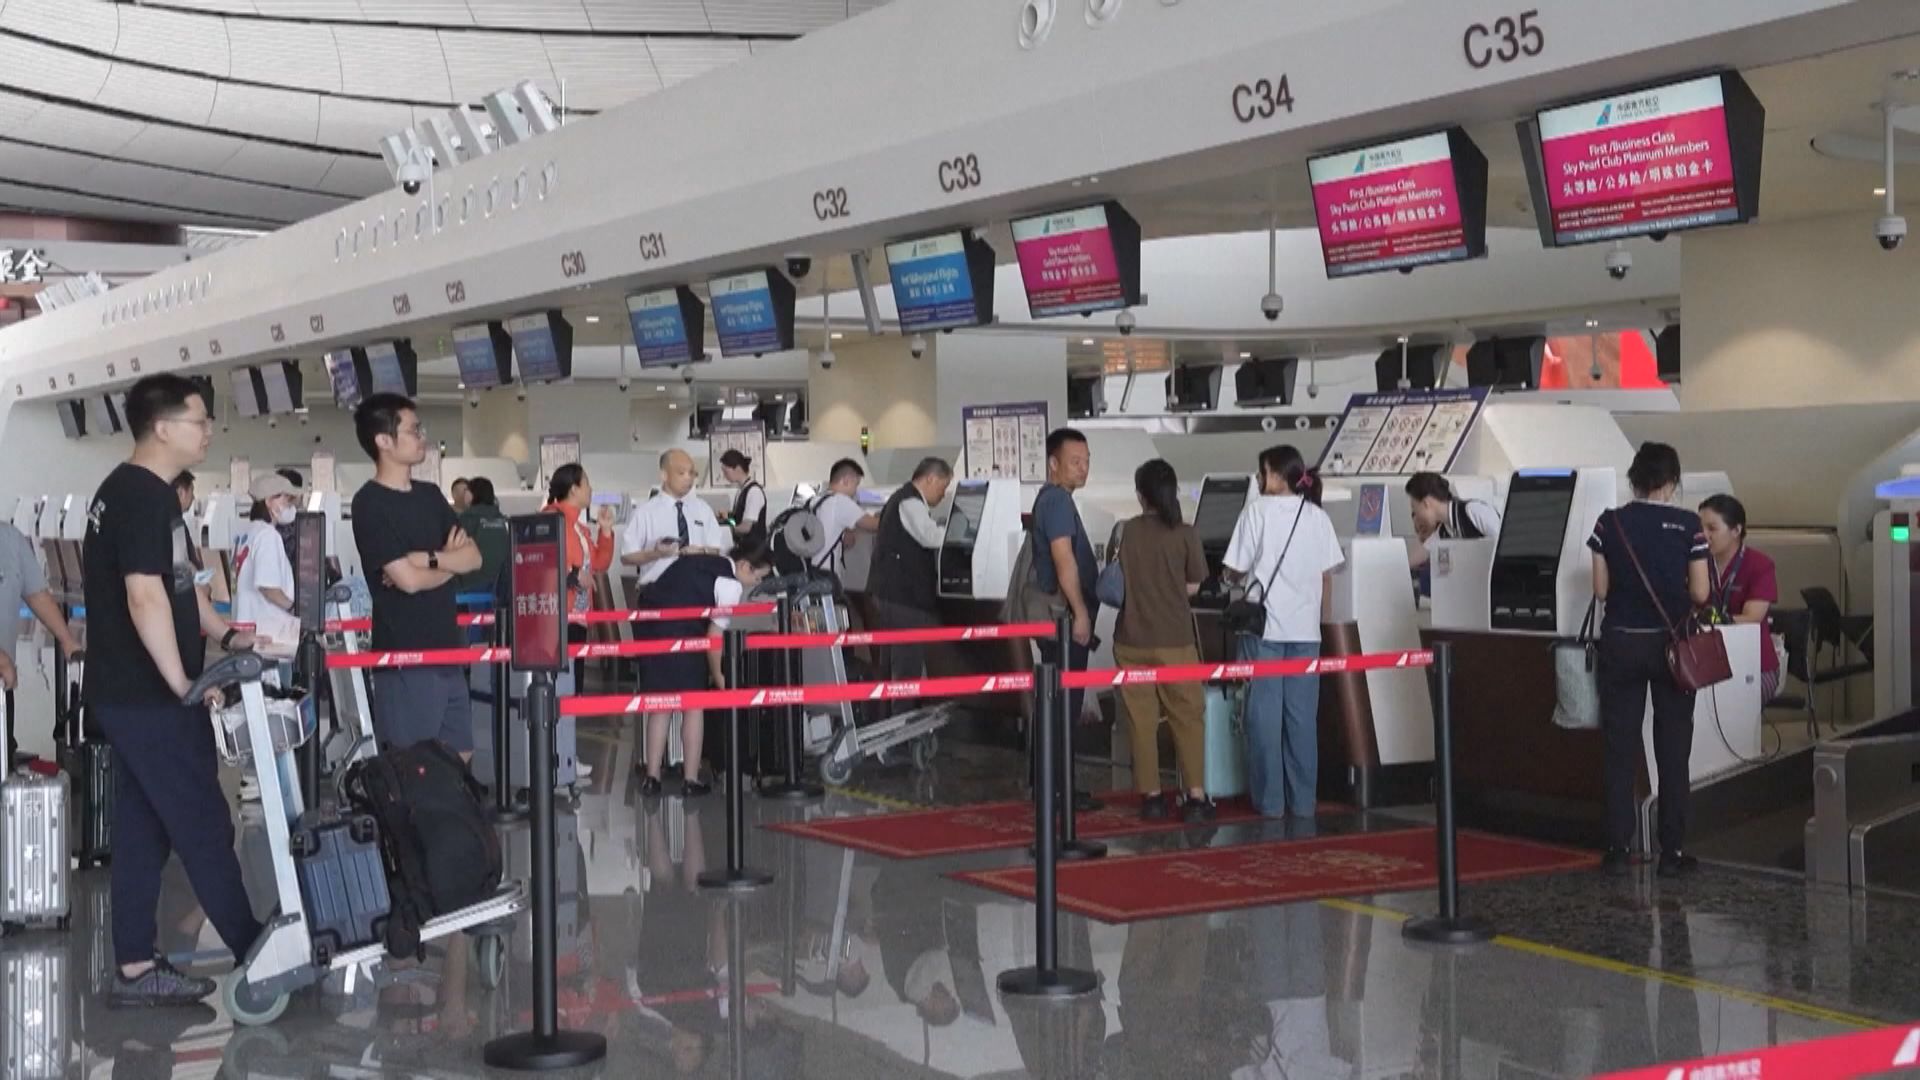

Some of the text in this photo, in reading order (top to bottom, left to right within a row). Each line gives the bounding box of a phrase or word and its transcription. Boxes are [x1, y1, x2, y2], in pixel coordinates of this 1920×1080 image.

[1463, 10, 1545, 69] C35
[1232, 73, 1294, 123] C34
[1589, 140, 1607, 157] First
[1652, 131, 1675, 144] Class
[1563, 140, 1710, 177] Sky Pearl Club Platinum Members
[938, 153, 981, 194] C33
[1397, 179, 1416, 190] Class
[813, 188, 851, 221] C32
[1360, 198, 1376, 210] Club
[1408, 187, 1442, 203] Members
[639, 232, 667, 261] C31
[561, 251, 586, 278] C30
[446, 280, 466, 304] C29
[516, 593, 559, 617] 首乘无忧
